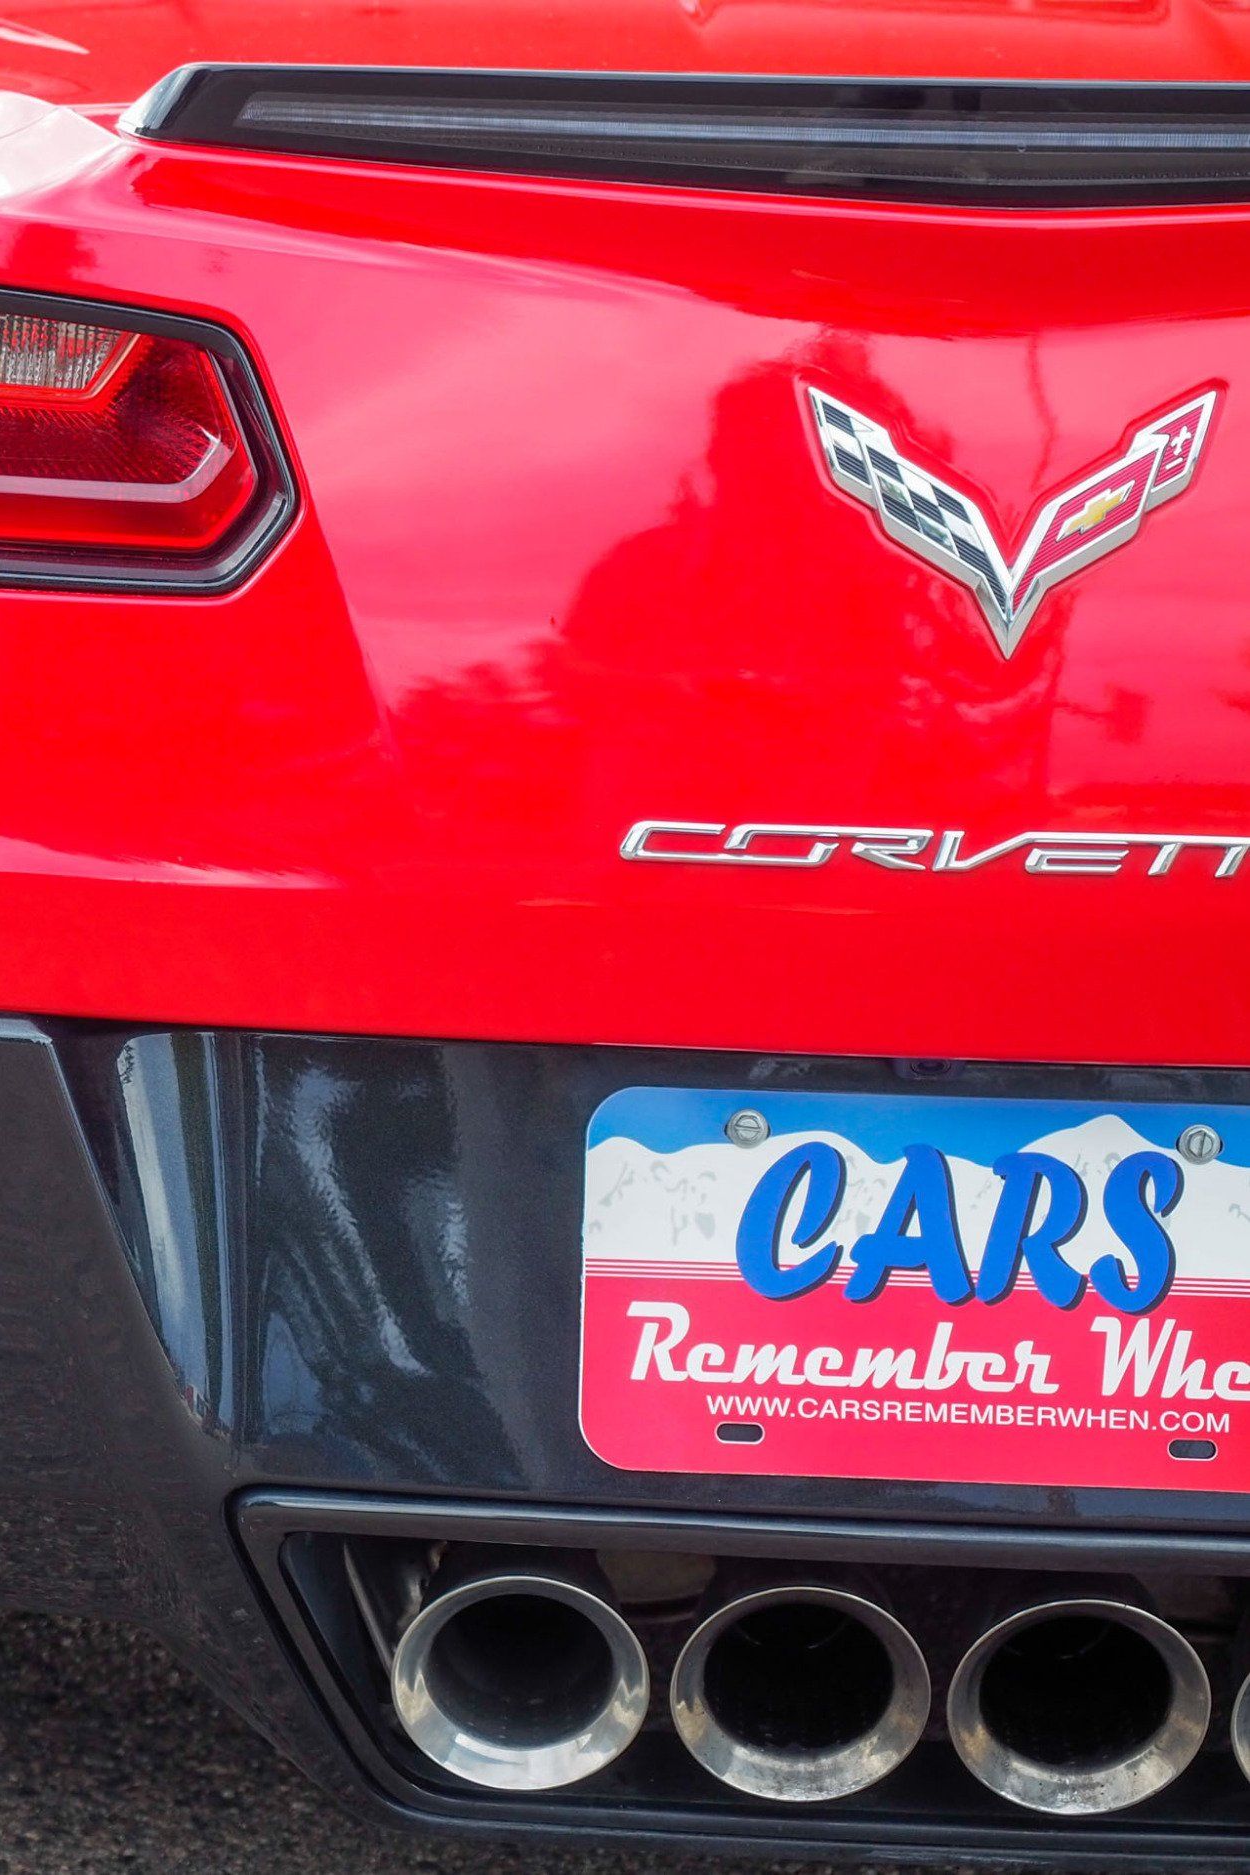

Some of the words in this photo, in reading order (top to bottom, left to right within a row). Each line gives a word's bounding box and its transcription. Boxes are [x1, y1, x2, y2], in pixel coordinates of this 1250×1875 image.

[735, 1141, 1185, 1316] CARS
[626, 1301, 1060, 1394] Remember
[706, 1394, 1230, 1433] WWW.CARSREMEMBERWHEN.COM
